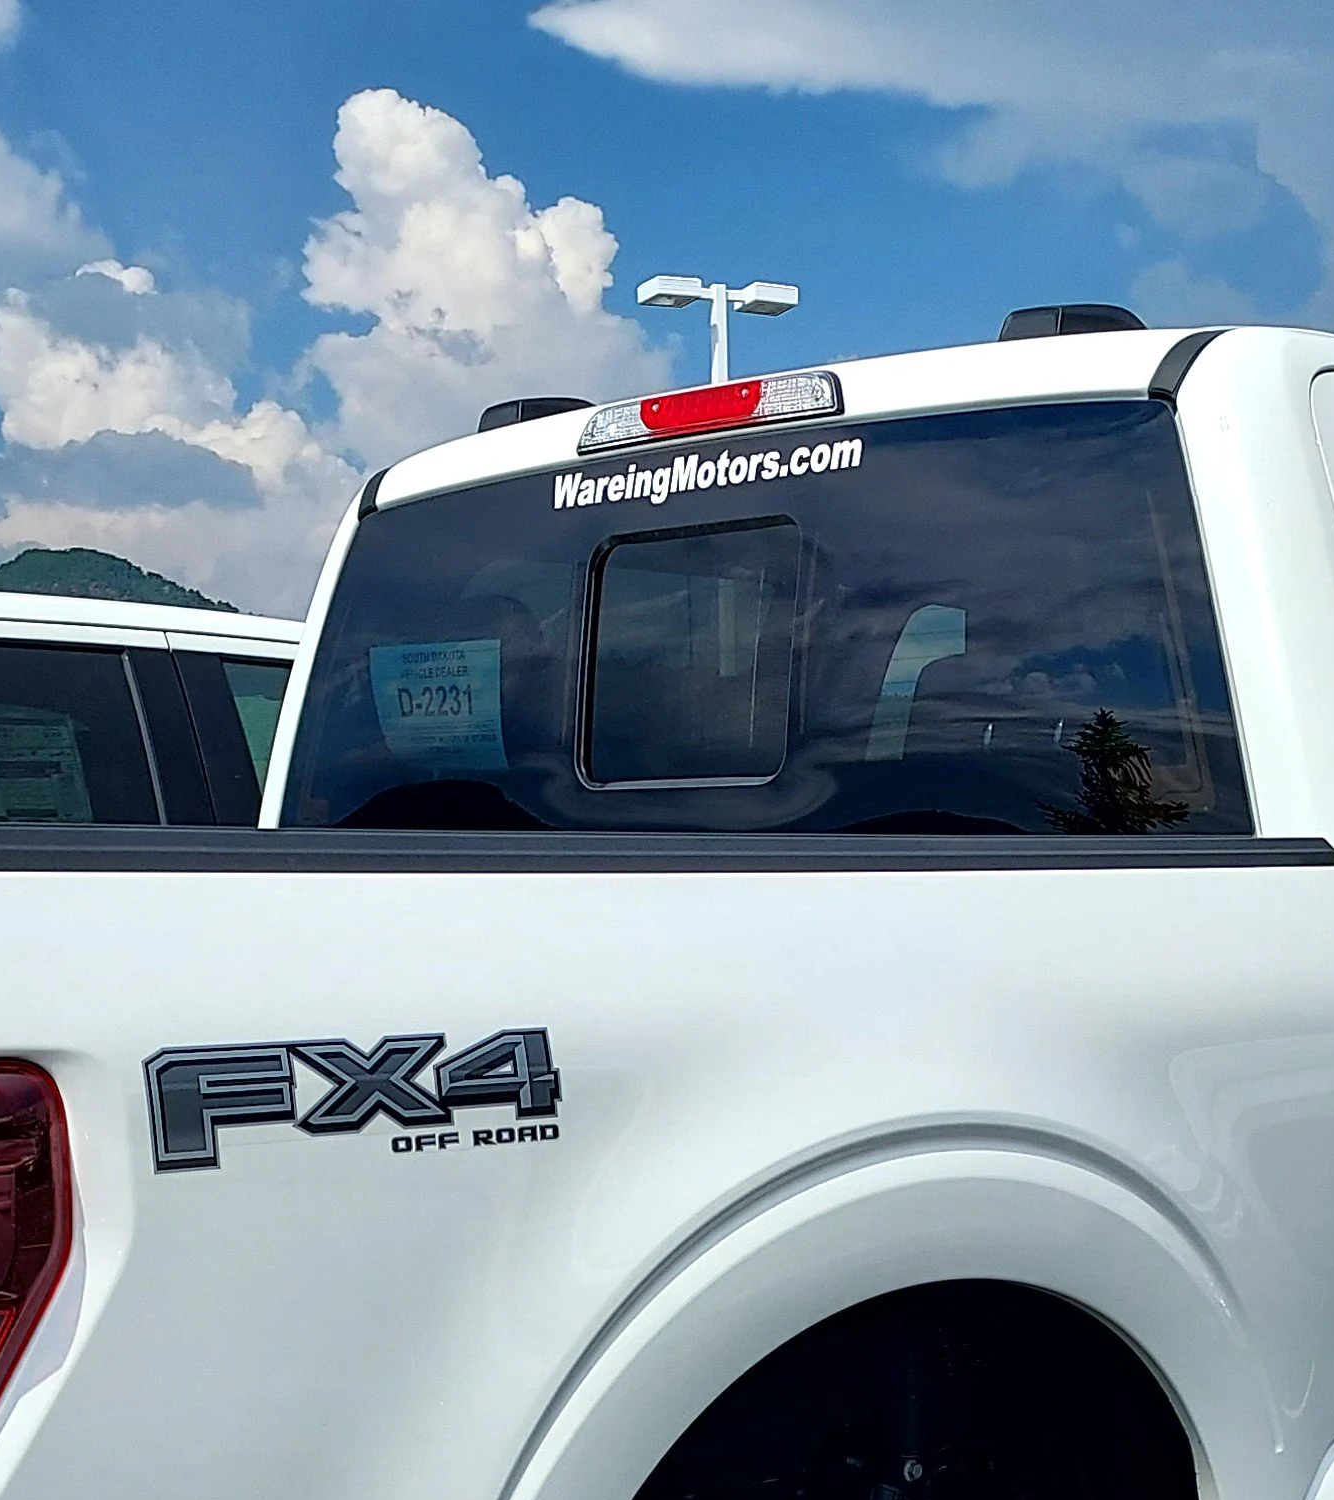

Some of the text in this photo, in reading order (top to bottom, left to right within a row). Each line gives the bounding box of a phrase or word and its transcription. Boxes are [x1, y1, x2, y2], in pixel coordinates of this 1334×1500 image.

[553, 438, 863, 509] WareingMotors.com
[397, 684, 473, 718] D-2231
[142, 1027, 563, 1175] FX4
[392, 1124, 560, 1154] OFF ROAD
